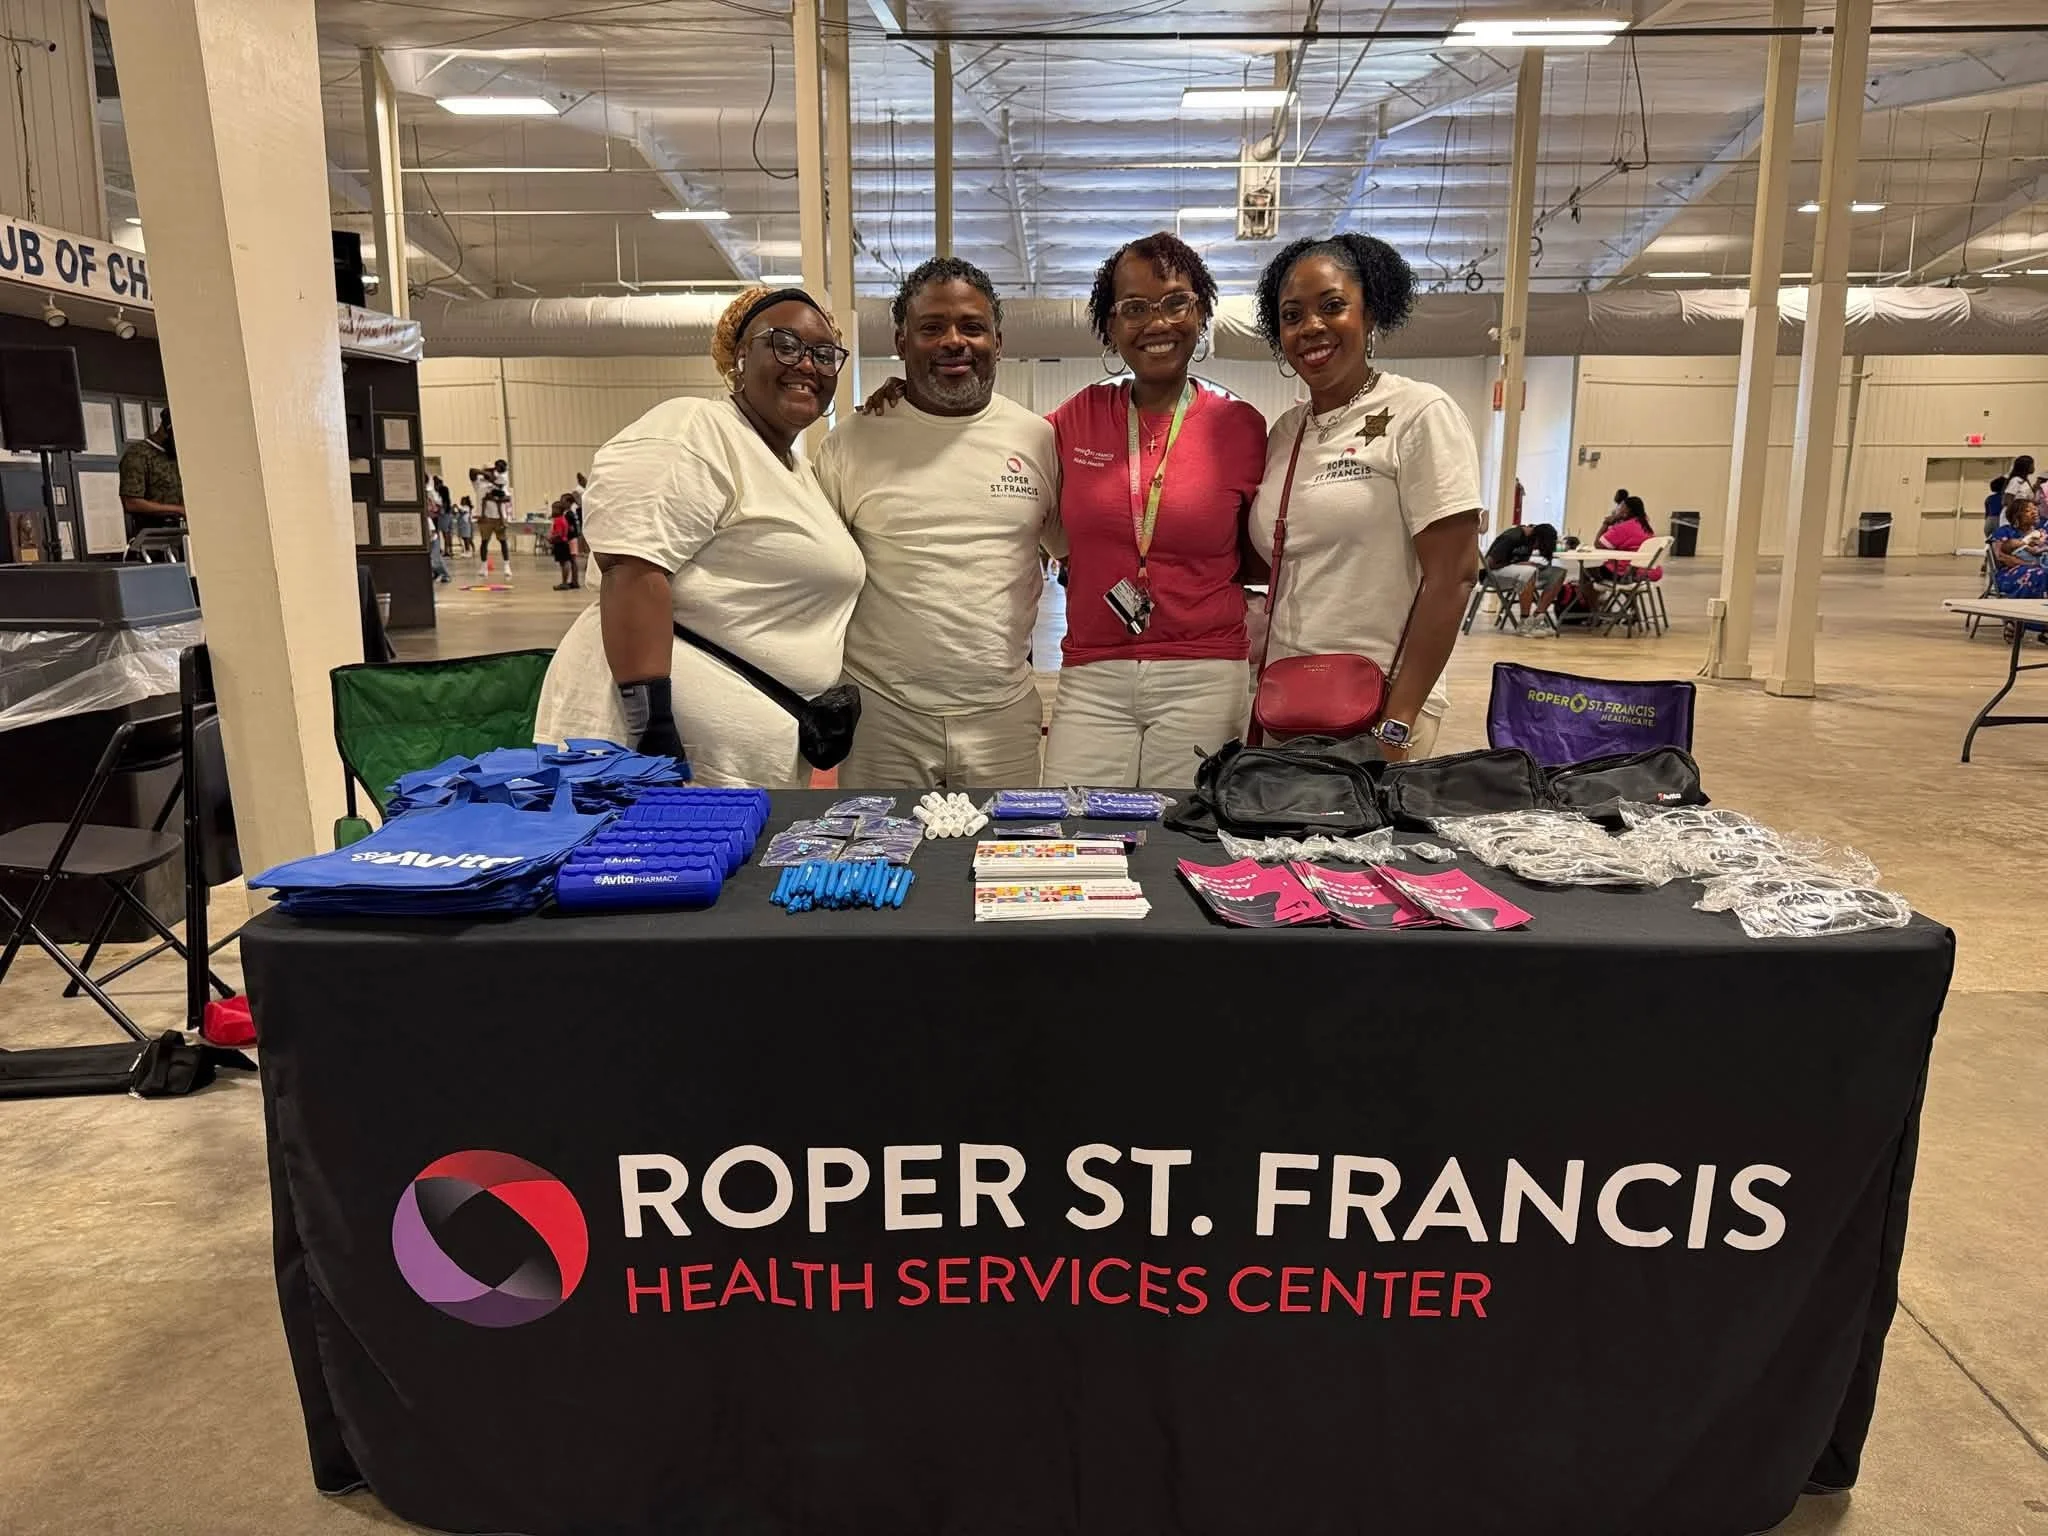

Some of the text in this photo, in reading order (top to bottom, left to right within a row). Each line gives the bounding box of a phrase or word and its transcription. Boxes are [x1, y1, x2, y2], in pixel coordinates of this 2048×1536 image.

[55, 239, 97, 287] OF
[107, 252, 153, 301] CH
[1001, 475, 1029, 485] ROPER
[1528, 690, 1570, 707] ROPER
[1600, 713, 1657, 728] HEALTHCARE
[601, 874, 679, 885] Avita PHARMACY
[618, 1143, 1792, 1251] ROPER ST. FRANCIS
[626, 1255, 1491, 1318] HEALTH SERVICES CENTER
